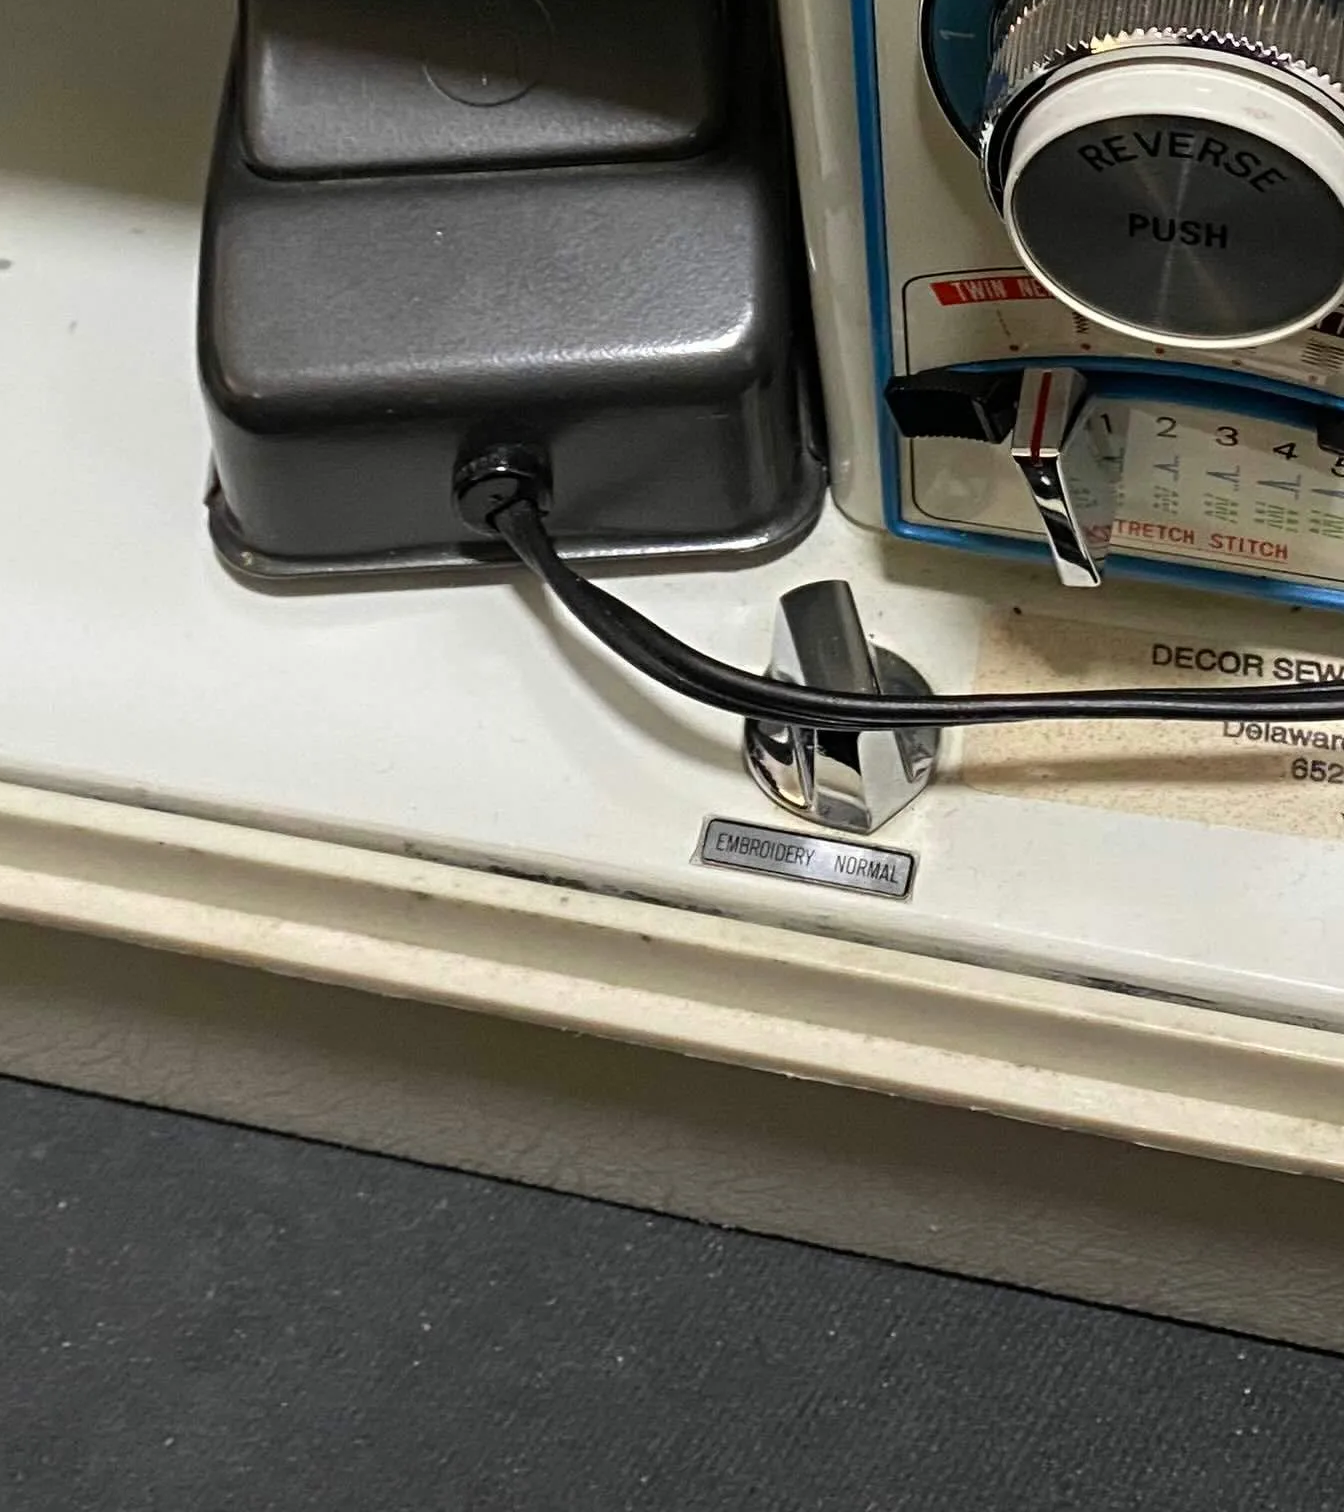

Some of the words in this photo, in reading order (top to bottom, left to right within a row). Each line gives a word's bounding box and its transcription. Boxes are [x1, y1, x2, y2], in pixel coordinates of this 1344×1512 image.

[1077, 130, 1289, 193] REVERSE
[1128, 212, 1229, 249] PUSH
[950, 279, 1007, 302] TWIN
[1100, 412, 1113, 434] 1
[1156, 416, 1177, 438] 2
[1215, 426, 1239, 447] 3
[1272, 442, 1298, 461] 4
[1113, 518, 1195, 546] TRETCH
[1207, 533, 1289, 562] STITCH
[1151, 642, 1265, 678] DECOR
[715, 831, 817, 868] EMBROIDERY
[834, 854, 900, 884] NORMAL
